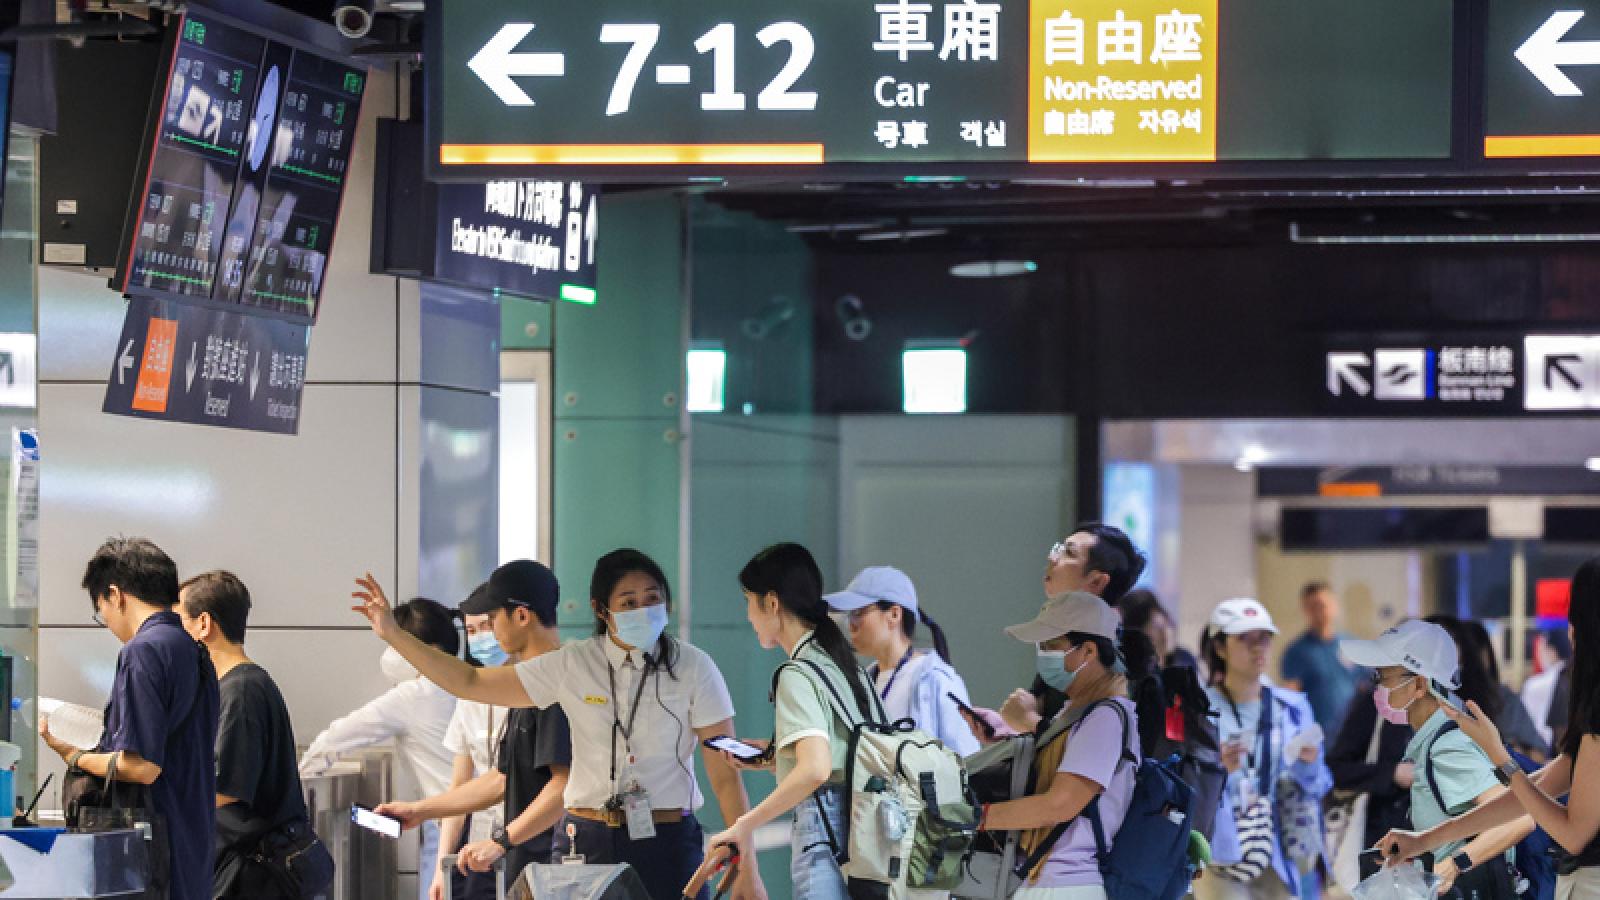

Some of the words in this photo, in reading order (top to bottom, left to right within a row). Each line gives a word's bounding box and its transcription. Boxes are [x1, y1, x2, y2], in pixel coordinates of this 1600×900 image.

[872, 0, 1001, 62] 車廂
[1044, 10, 1204, 65] 自由座
[599, 21, 819, 116] 7-12
[873, 76, 931, 107] Car
[1043, 74, 1202, 100] Non-Reserved
